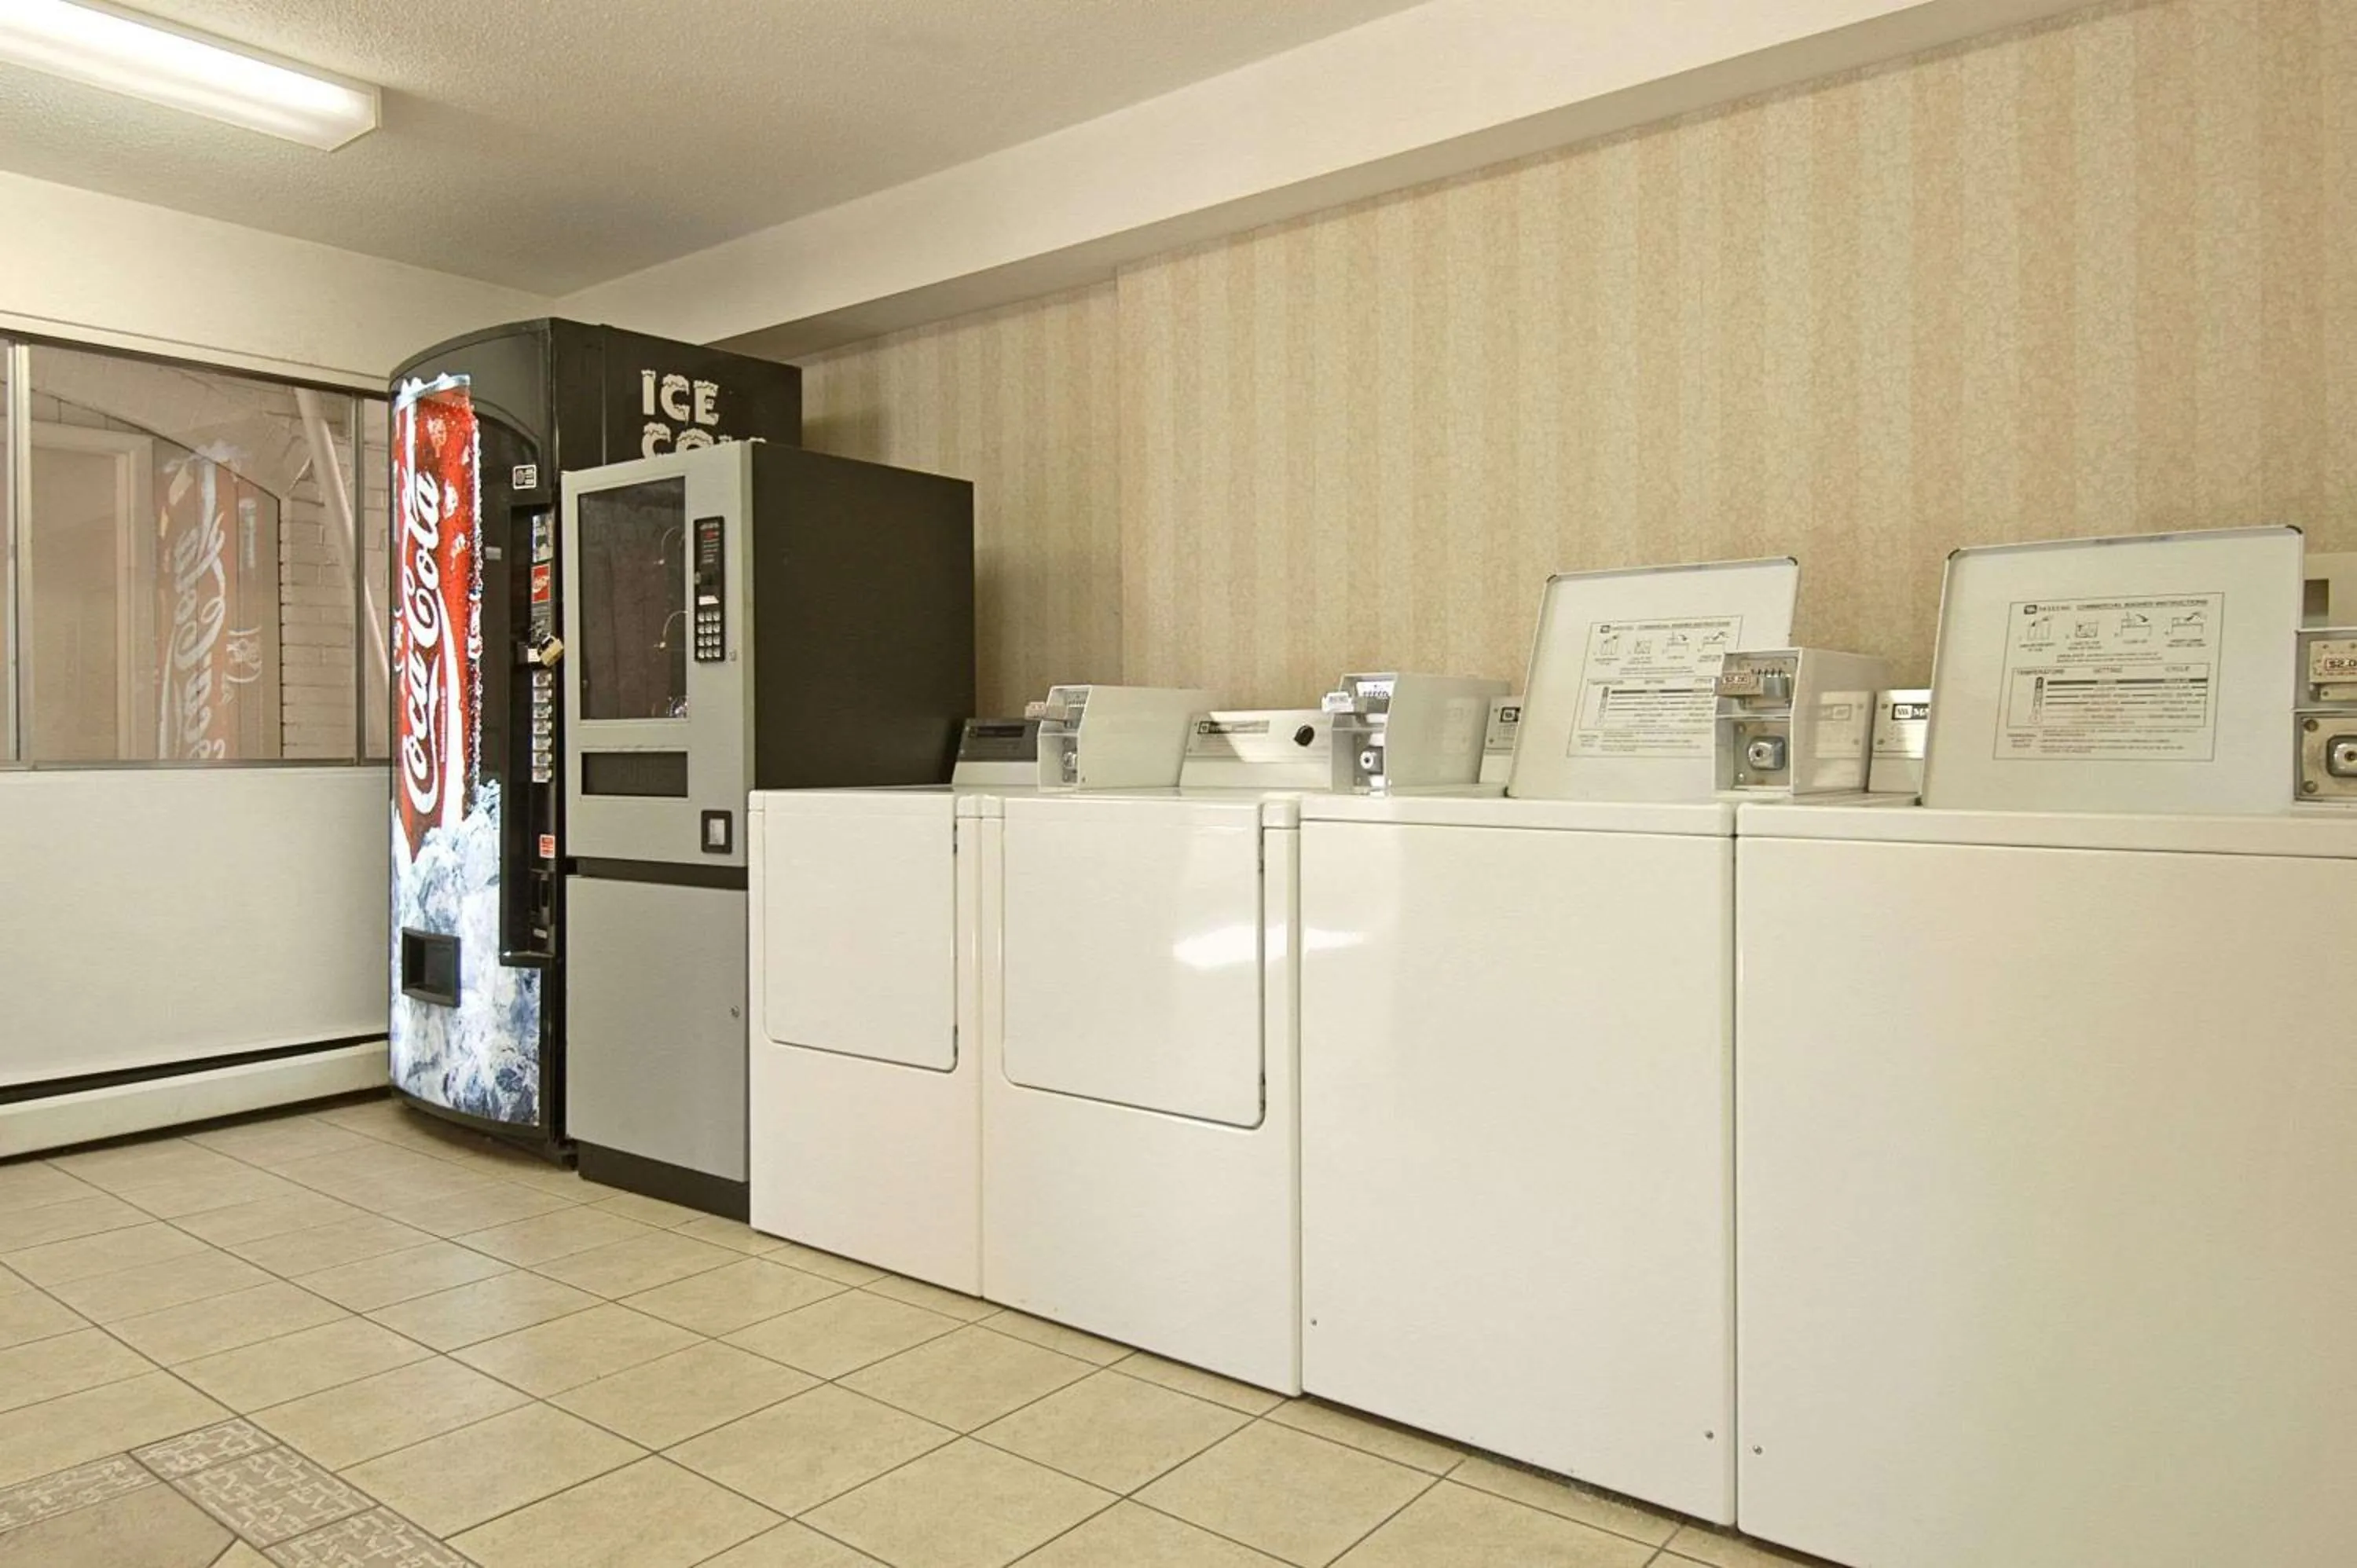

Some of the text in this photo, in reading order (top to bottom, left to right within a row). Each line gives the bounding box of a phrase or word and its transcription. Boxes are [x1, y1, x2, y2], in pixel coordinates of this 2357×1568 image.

[641, 369, 720, 426] ICE
[641, 422, 767, 459] CO
[401, 470, 439, 815] Coca-Cola
